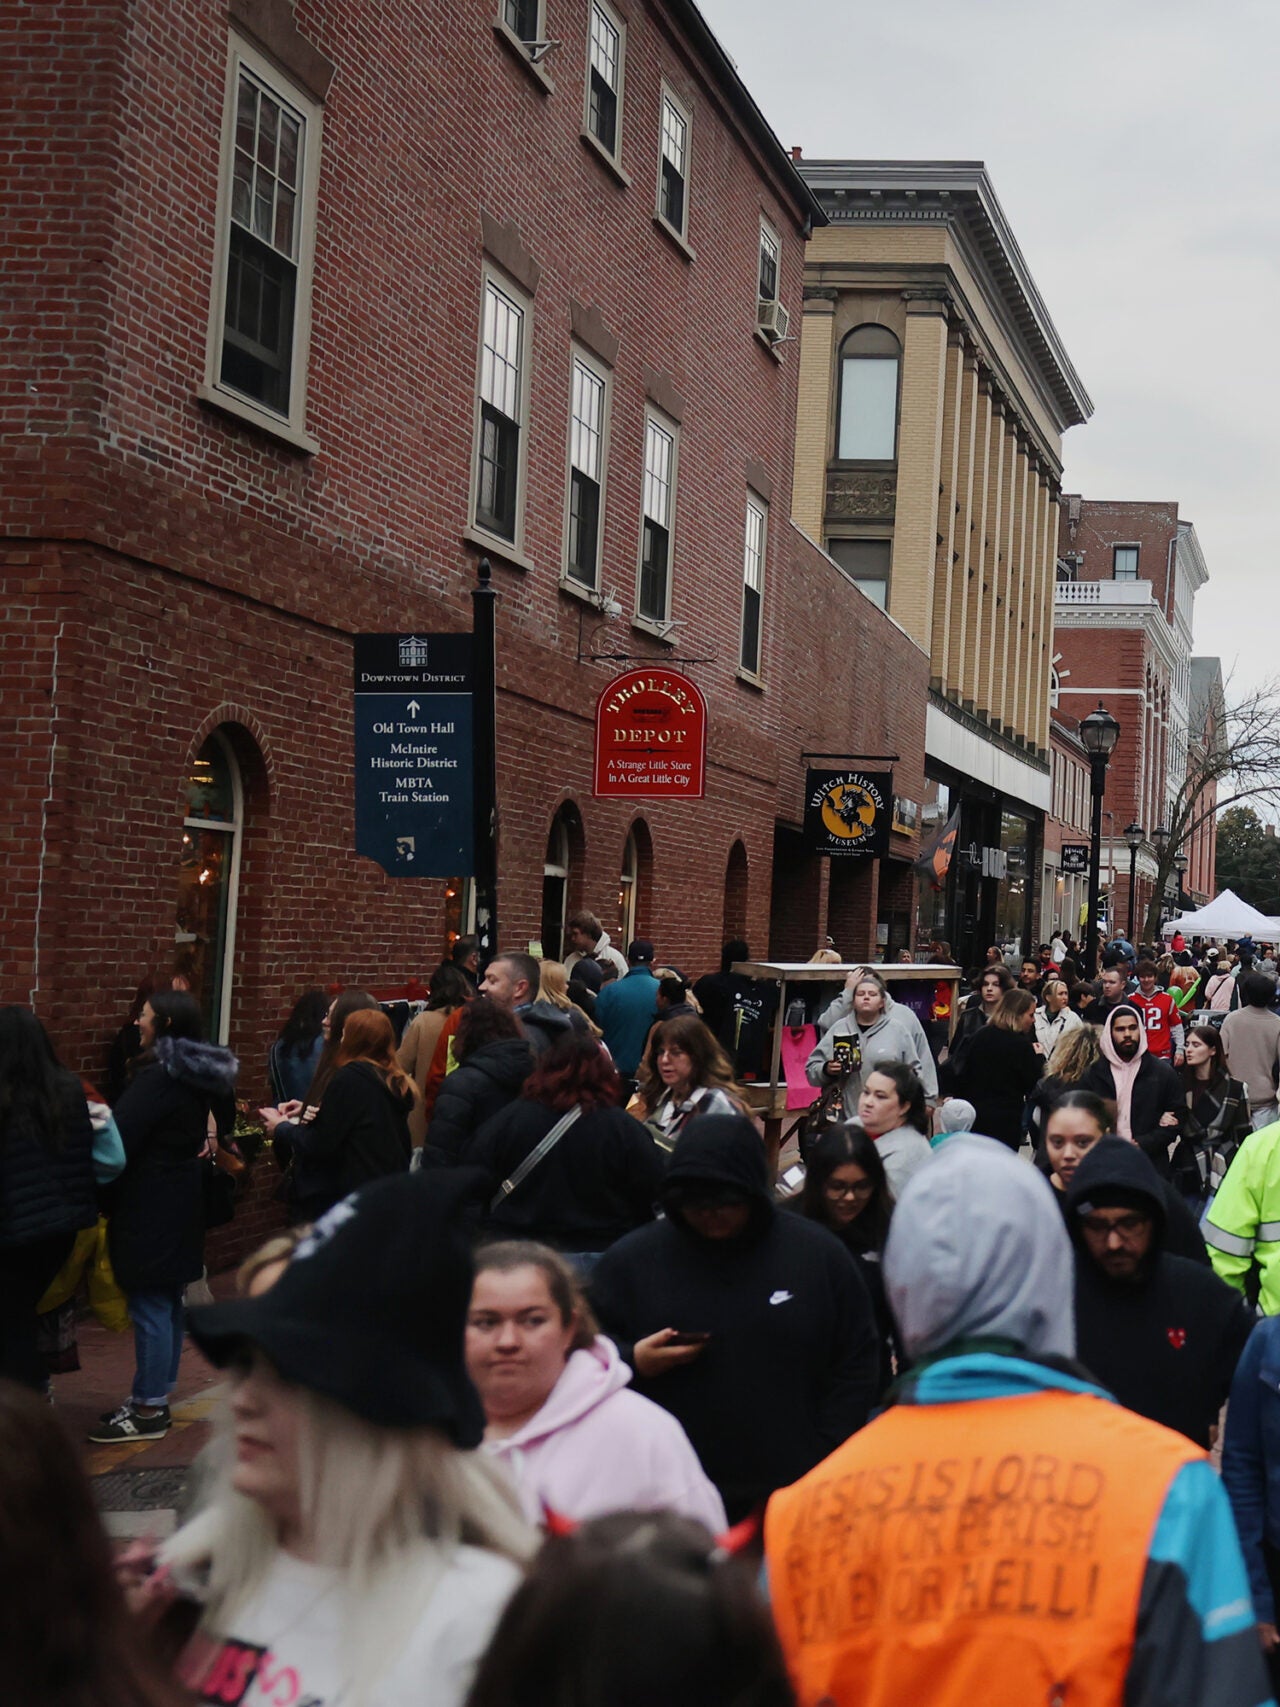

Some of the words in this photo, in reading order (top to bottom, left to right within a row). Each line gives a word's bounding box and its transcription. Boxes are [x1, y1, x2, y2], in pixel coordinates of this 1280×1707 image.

[605, 678, 696, 715] TROLLEY
[373, 722, 394, 734] Old
[396, 722, 427, 734] Town
[431, 722, 455, 734] Hall
[613, 729, 687, 743] DEPOT
[390, 743, 438, 754] McIntire
[371, 757, 413, 768] Historic
[417, 757, 458, 768] District
[607, 760, 615, 769] A
[617, 760, 646, 772] Strange
[649, 760, 668, 770] Little
[671, 760, 691, 770] Store
[395, 777, 433, 789] MBTA
[609, 773, 616, 783] In
[618, 773, 626, 783] A
[628, 773, 650, 783] Great
[652, 774, 672, 784] Little
[674, 774, 690, 787] City
[379, 791, 409, 802] Train
[412, 791, 449, 802] Station
[827, 833, 867, 847] MUSEUM
[964, 1452, 1106, 1512] LORD
[957, 1557, 1103, 1620] HELL!
